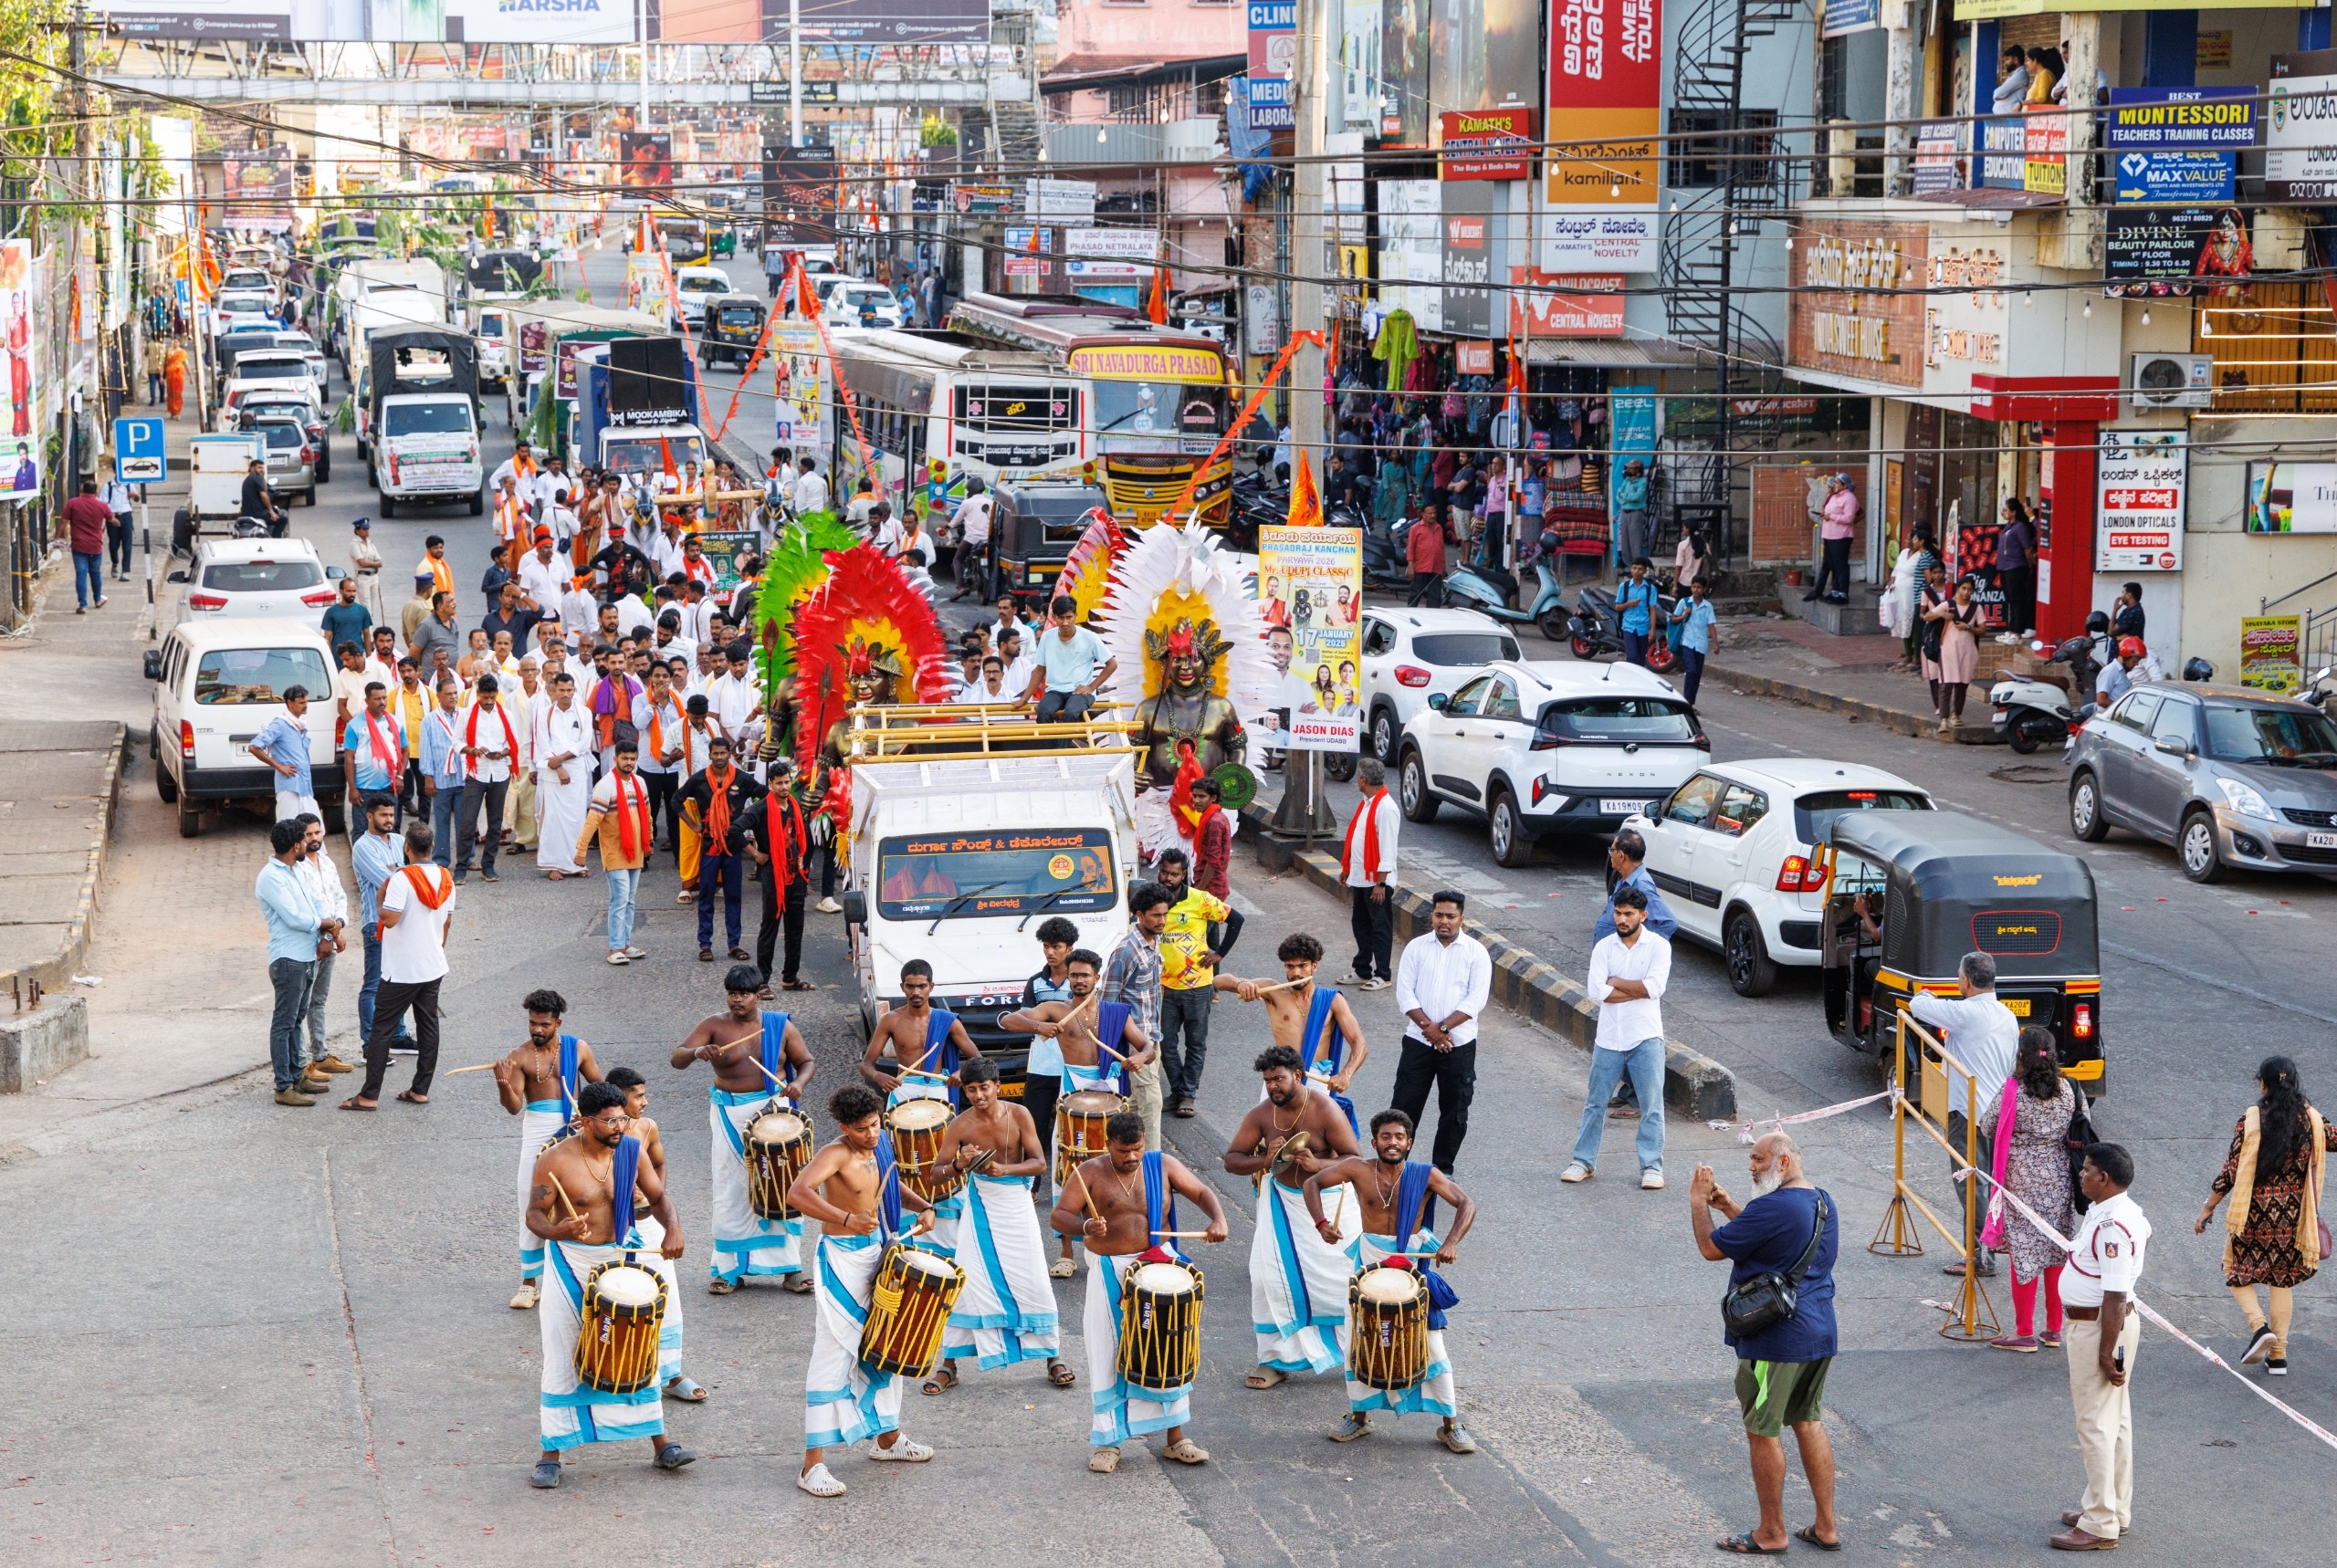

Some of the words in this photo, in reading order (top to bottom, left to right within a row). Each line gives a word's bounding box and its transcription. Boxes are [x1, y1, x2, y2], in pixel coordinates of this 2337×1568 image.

[2169, 92, 2201, 101] BEST
[2118, 104, 2250, 125] MONTESSORI
[1459, 117, 1512, 133] KAMATH'S
[1984, 126, 2025, 151] COMPUTER
[2112, 129, 2162, 141] TEACHERS
[2164, 129, 2209, 141] TRAINING
[2211, 128, 2254, 140] CLASSES
[1444, 138, 1484, 157] CENTRAL
[1487, 136, 1527, 157] NOVELTY
[1467, 164, 1481, 172] Bags
[1505, 162, 1520, 172] Shop
[1984, 156, 2025, 179] EDUCATION
[1564, 170, 1641, 185] kamiliant
[2151, 190, 2200, 200] Transforming
[2203, 189, 2219, 199] Life
[2118, 226, 2186, 240] DIVINE
[2108, 241, 2147, 250] BEAUTY
[2149, 240, 2195, 249] PARLOUR
[1594, 249, 1639, 257] NOVELTY
[1551, 313, 1585, 328] CENTRAL
[1588, 314, 1624, 329] NOVELTY
[1835, 313, 1860, 358] SWEET
[1072, 353, 1093, 372] SRI
[1096, 353, 1167, 375] NAVADURGA
[1170, 355, 1218, 376] PRASAD
[627, 409, 687, 419] MOOKAMBIKA
[129, 423, 151, 454] P
[2101, 467, 2138, 481] ಲಂಡನ್
[2103, 517, 2135, 528] LONDON
[2138, 516, 2176, 528] OPTICALS
[2111, 536, 2127, 545] EYE
[2130, 535, 2168, 545] TESTING
[1262, 544, 1312, 552] PRASADRAJ
[1315, 545, 1357, 554] KANCHAN
[1277, 556, 1314, 564] PARYAYA
[1316, 557, 1336, 565] 2026
[1264, 565, 1279, 575] Mr.
[1281, 566, 1310, 579] UDUPI
[1313, 567, 1353, 577] CLASSIC
[1296, 628, 1318, 646] 17
[1319, 629, 1354, 639] JANUARY
[2247, 628, 2296, 644] ವಿನಾಯಕ
[1293, 725, 1326, 735] JASON
[1330, 726, 1354, 736] DIAS
[907, 841, 947, 853] ದುರ್ಗಾ
[952, 838, 992, 852] ಸೌಂಡ್ಸ್
[995, 839, 1006, 849] &
[976, 901, 988, 910] ಶ್ರೀ
